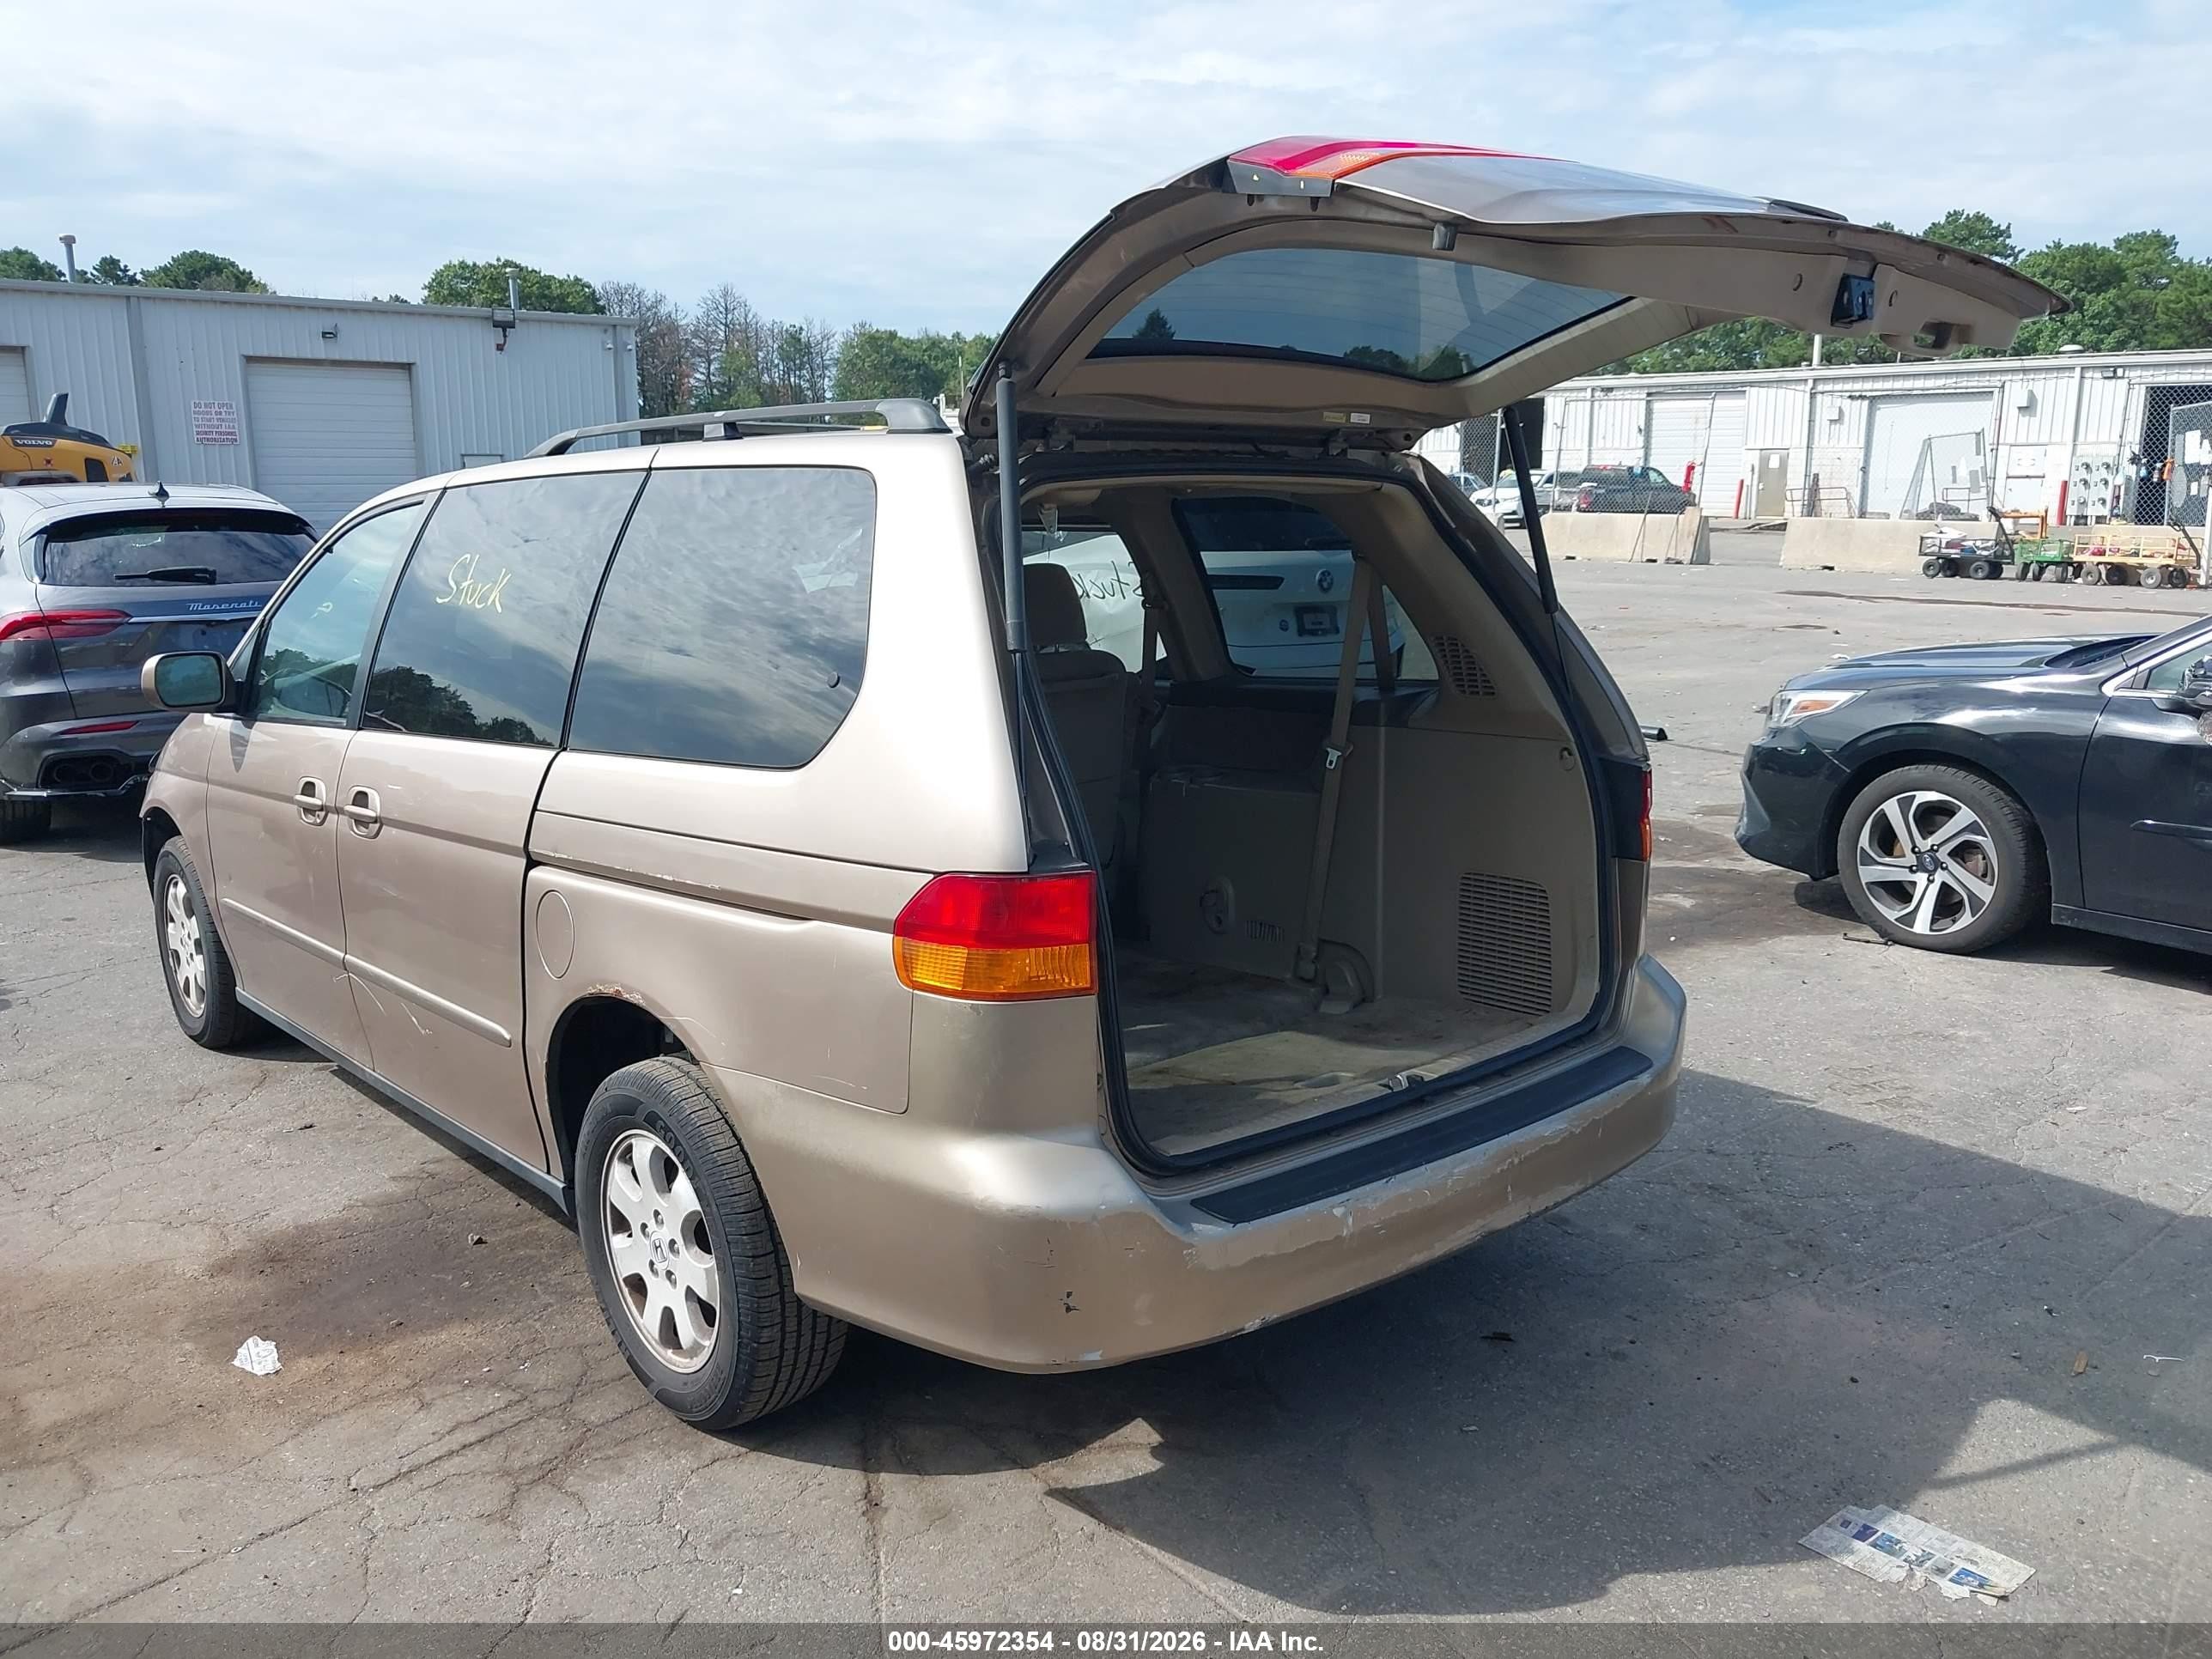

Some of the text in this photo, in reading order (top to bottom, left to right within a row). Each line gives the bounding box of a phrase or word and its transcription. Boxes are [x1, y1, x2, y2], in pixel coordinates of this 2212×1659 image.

[204, 401, 216, 410] NOT
[217, 402, 234, 410] OPEN
[186, 600, 263, 611] Maserati
